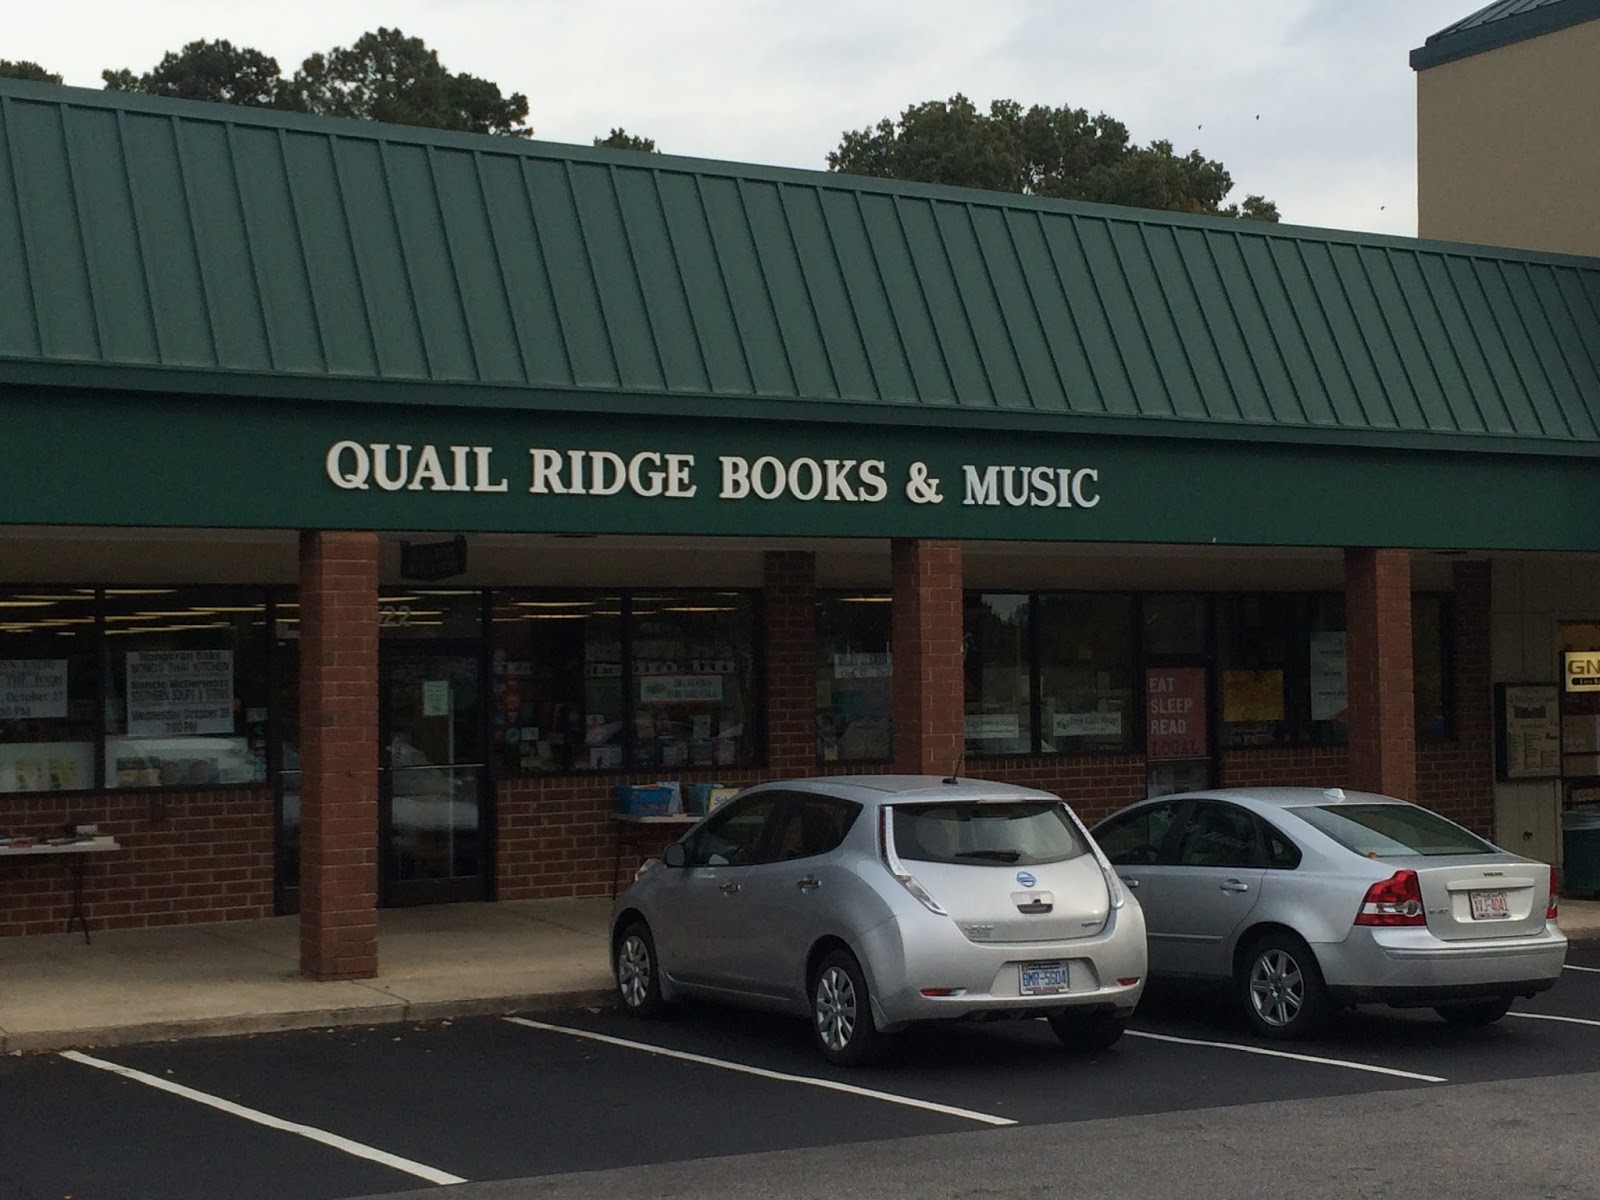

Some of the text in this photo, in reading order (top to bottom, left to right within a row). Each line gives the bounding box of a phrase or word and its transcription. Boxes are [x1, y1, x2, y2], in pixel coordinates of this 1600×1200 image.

[326, 440, 1101, 510] QUAIL RIDGE BOOKS & MUSIC
[1149, 677, 1175, 693] EAT
[1150, 697, 1193, 714] SLEEP
[1150, 719, 1187, 736] READ
